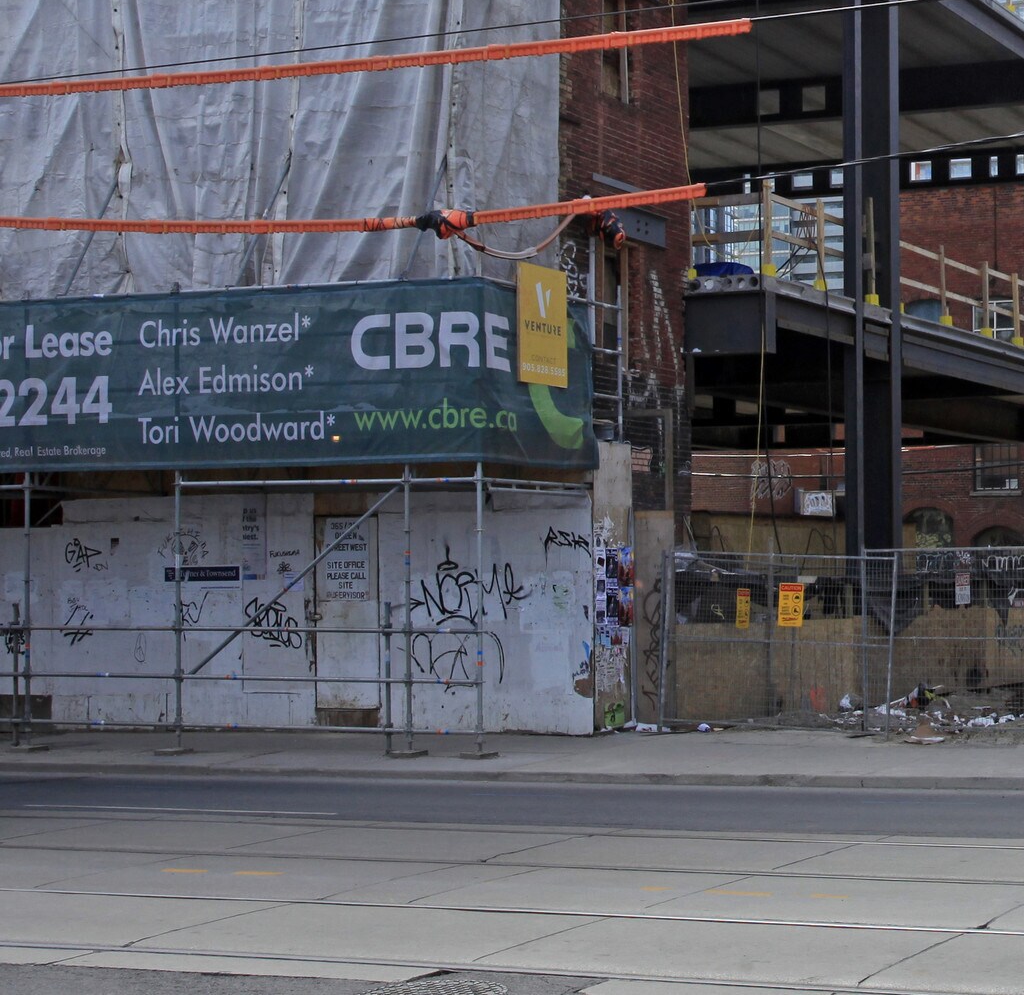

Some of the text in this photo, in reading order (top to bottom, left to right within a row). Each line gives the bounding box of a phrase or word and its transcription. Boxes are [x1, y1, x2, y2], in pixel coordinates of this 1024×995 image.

[139, 319, 201, 348] Chris
[524, 319, 562, 337] VENTURE
[0, 324, 113, 360] r Lease
[350, 311, 511, 372] CBRE
[138, 367, 190, 396] Alex
[0, 375, 113, 427] 2244
[354, 398, 517, 431] www.cbre.ca
[138, 416, 179, 444] Tori
[0, 445, 106, 459] ed, Real Estate Brokerage
[350, 543, 367, 552] WEST
[179, 569, 199, 578] Tuner
[206, 568, 237, 578] Townsend
[326, 572, 367, 580] PLEASE CALL
[327, 560, 365, 570] SITE OFFICE
[338, 581, 353, 590] SITE
